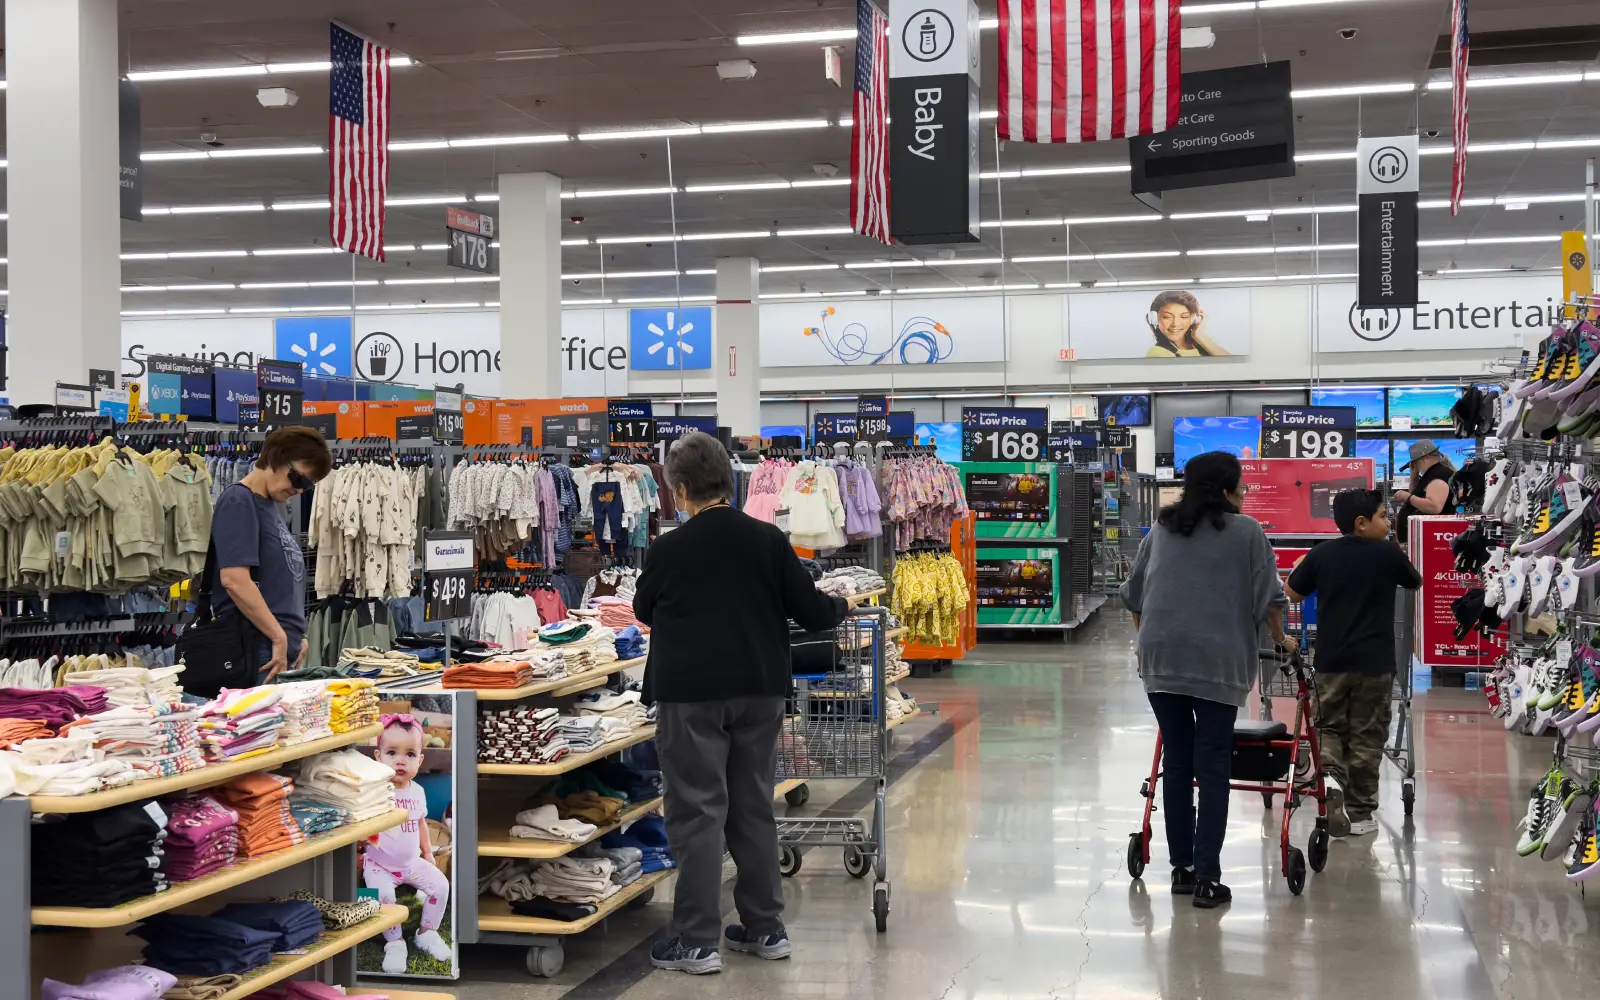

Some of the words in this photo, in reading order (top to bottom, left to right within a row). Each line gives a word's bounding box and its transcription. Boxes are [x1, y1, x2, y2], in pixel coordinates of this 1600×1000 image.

[1180, 94, 1195, 102] to
[1197, 90, 1222, 100] Care
[907, 87, 944, 161] Baby
[1178, 116, 1188, 125] et
[1190, 113, 1215, 124] Care
[1172, 135, 1218, 150] Sporting
[1220, 129, 1255, 143] Goods
[457, 214, 480, 229] Rollback
[452, 231, 487, 269] $178
[1380, 200, 1396, 297] Entertainment
[562, 336, 628, 372] fice
[155, 361, 171, 372] Digital
[172, 363, 191, 374] Gaming
[191, 364, 205, 374] Cards
[270, 373, 282, 383] Low
[281, 376, 295, 385] Price
[160, 388, 179, 399] XBOX
[559, 403, 589, 412] watch
[618, 408, 631, 416] Low
[630, 408, 645, 416] Price
[979, 415, 1001, 426] Low
[1000, 415, 1027, 426] Price
[1282, 415, 1305, 425] Low
[1307, 415, 1335, 425] Price
[657, 425, 673, 434] ow
[675, 424, 699, 434] Price
[973, 431, 1039, 460] $168
[1270, 430, 1344, 459] $198
[435, 543, 465, 556] Garanimals
